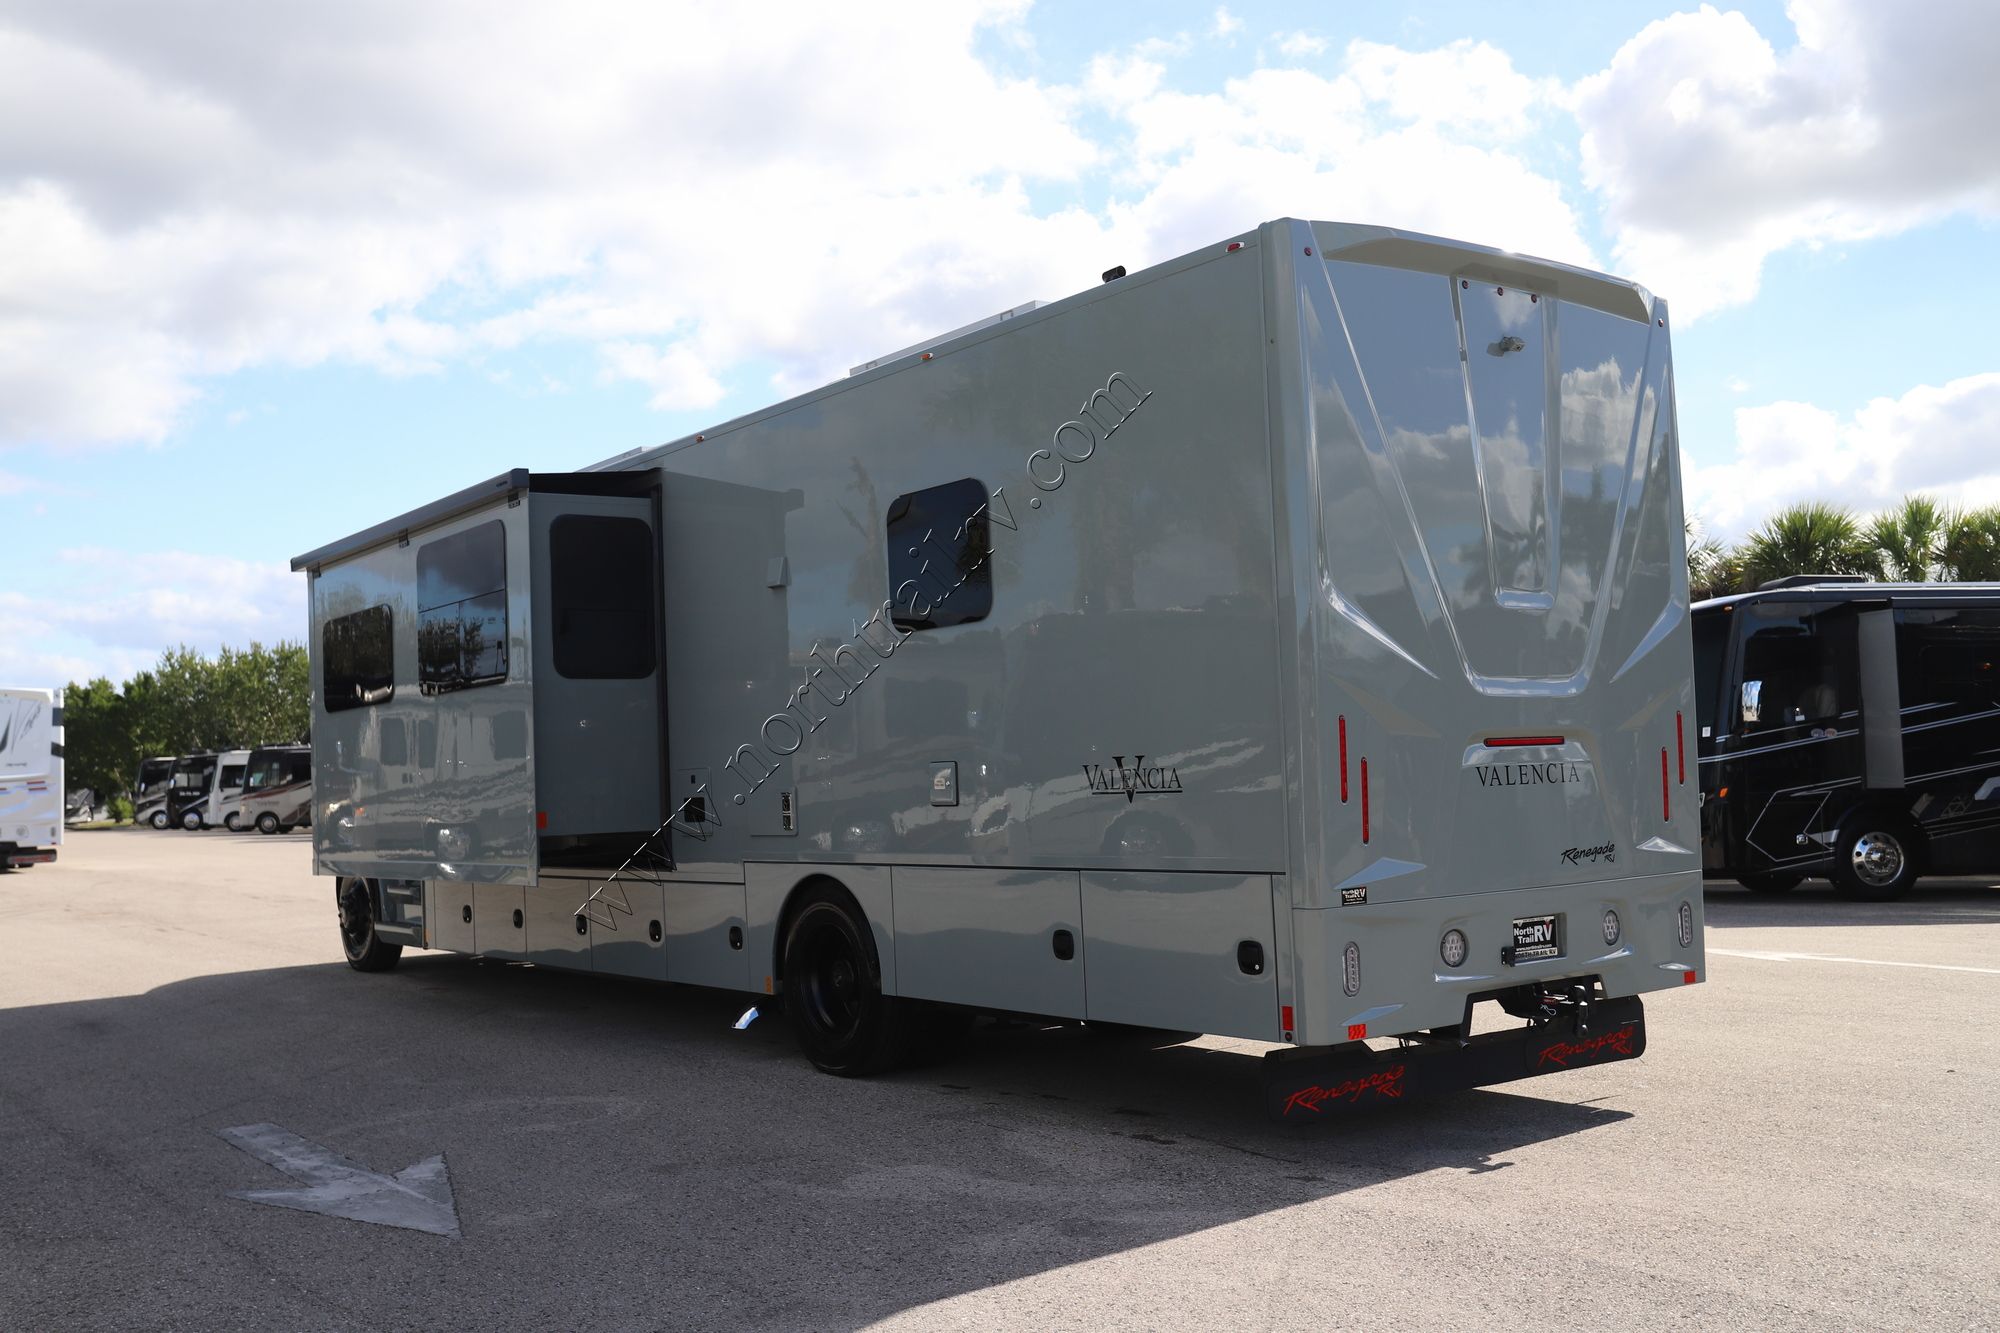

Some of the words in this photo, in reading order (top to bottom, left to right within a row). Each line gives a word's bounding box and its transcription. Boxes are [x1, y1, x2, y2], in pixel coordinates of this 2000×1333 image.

[1082, 764, 1183, 791] VALENCIA
[1475, 762, 1581, 787] VALENCIA
[1561, 840, 1615, 865] Renegade
[1604, 853, 1616, 863] RV
[1354, 889, 1365, 897] RV
[1514, 927, 1534, 936] North
[1518, 935, 1534, 944] Trail
[1534, 924, 1552, 942] RV
[1537, 1025, 1634, 1069] Renegade
[1283, 1064, 1405, 1116] Renegade
